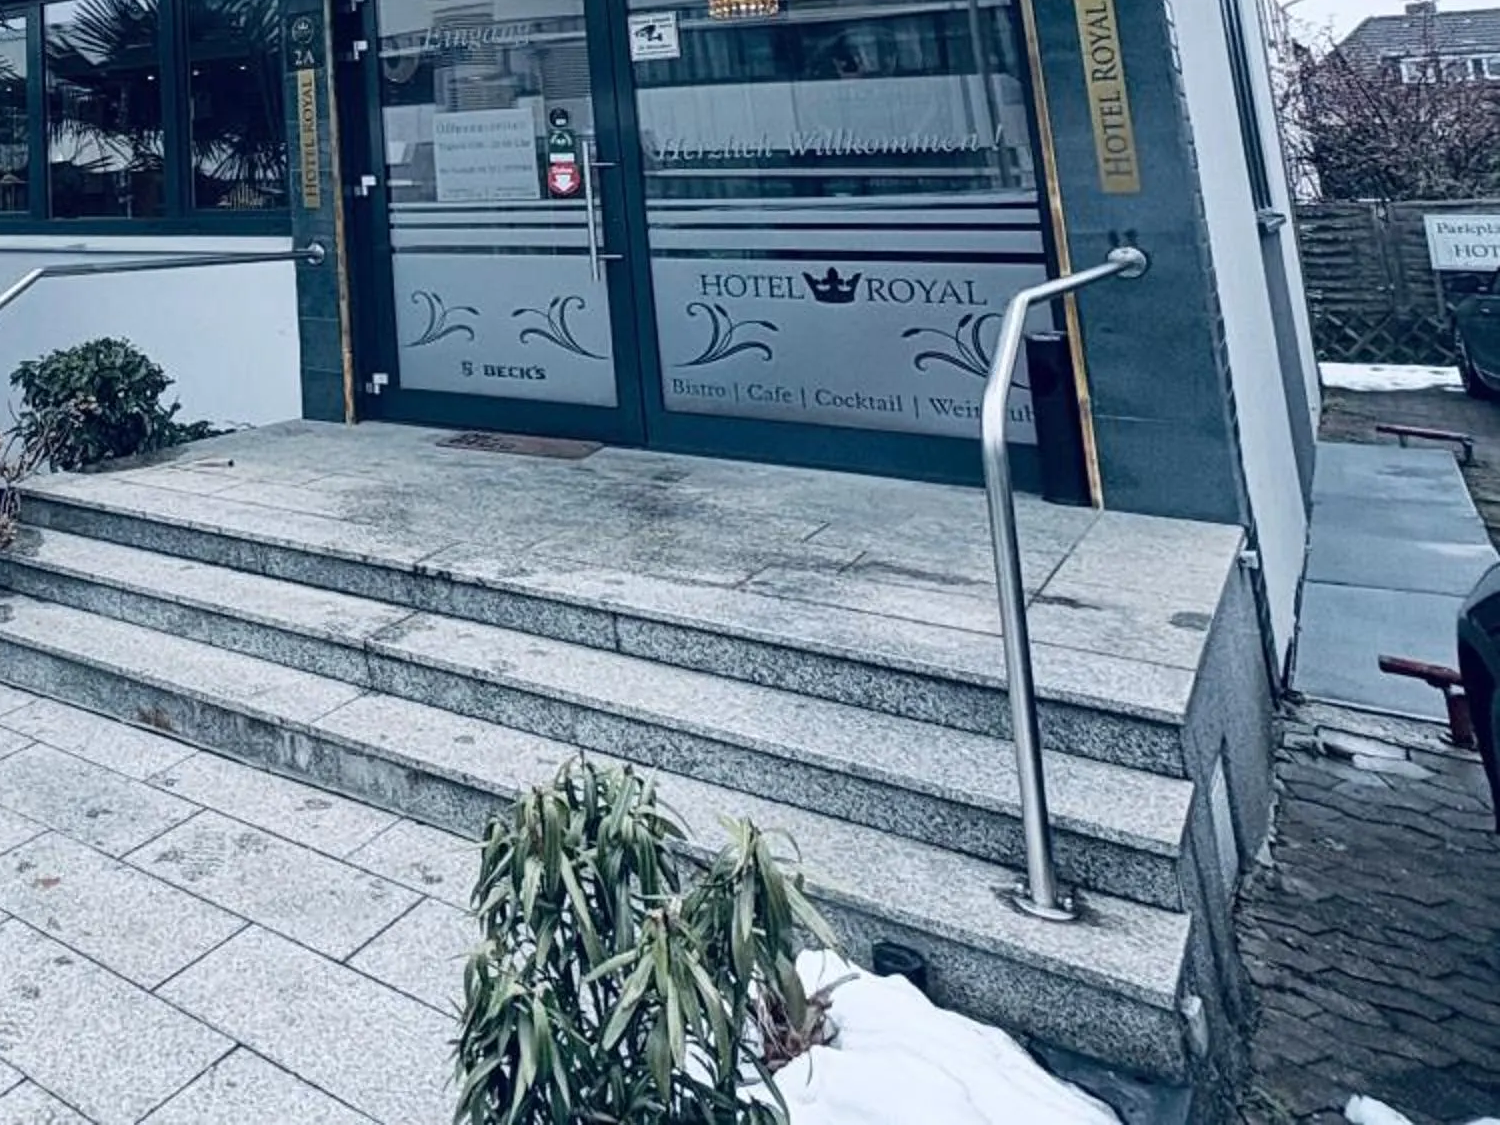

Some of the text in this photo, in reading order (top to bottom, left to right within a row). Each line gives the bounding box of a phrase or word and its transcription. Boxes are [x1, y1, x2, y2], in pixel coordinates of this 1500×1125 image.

[421, 24, 531, 52] Eingang
[1085, 0, 1135, 178] HOTEL ROYAL
[301, 80, 318, 197] HOTEL ROYAL
[655, 132, 773, 161] Herzlich
[788, 127, 980, 157] Willkommen
[700, 273, 988, 306] HOTEL ROYAL
[482, 364, 547, 380] BECK'S
[671, 378, 727, 399] Bistro
[747, 383, 794, 404] Cafe
[814, 388, 903, 413] Cocktail
